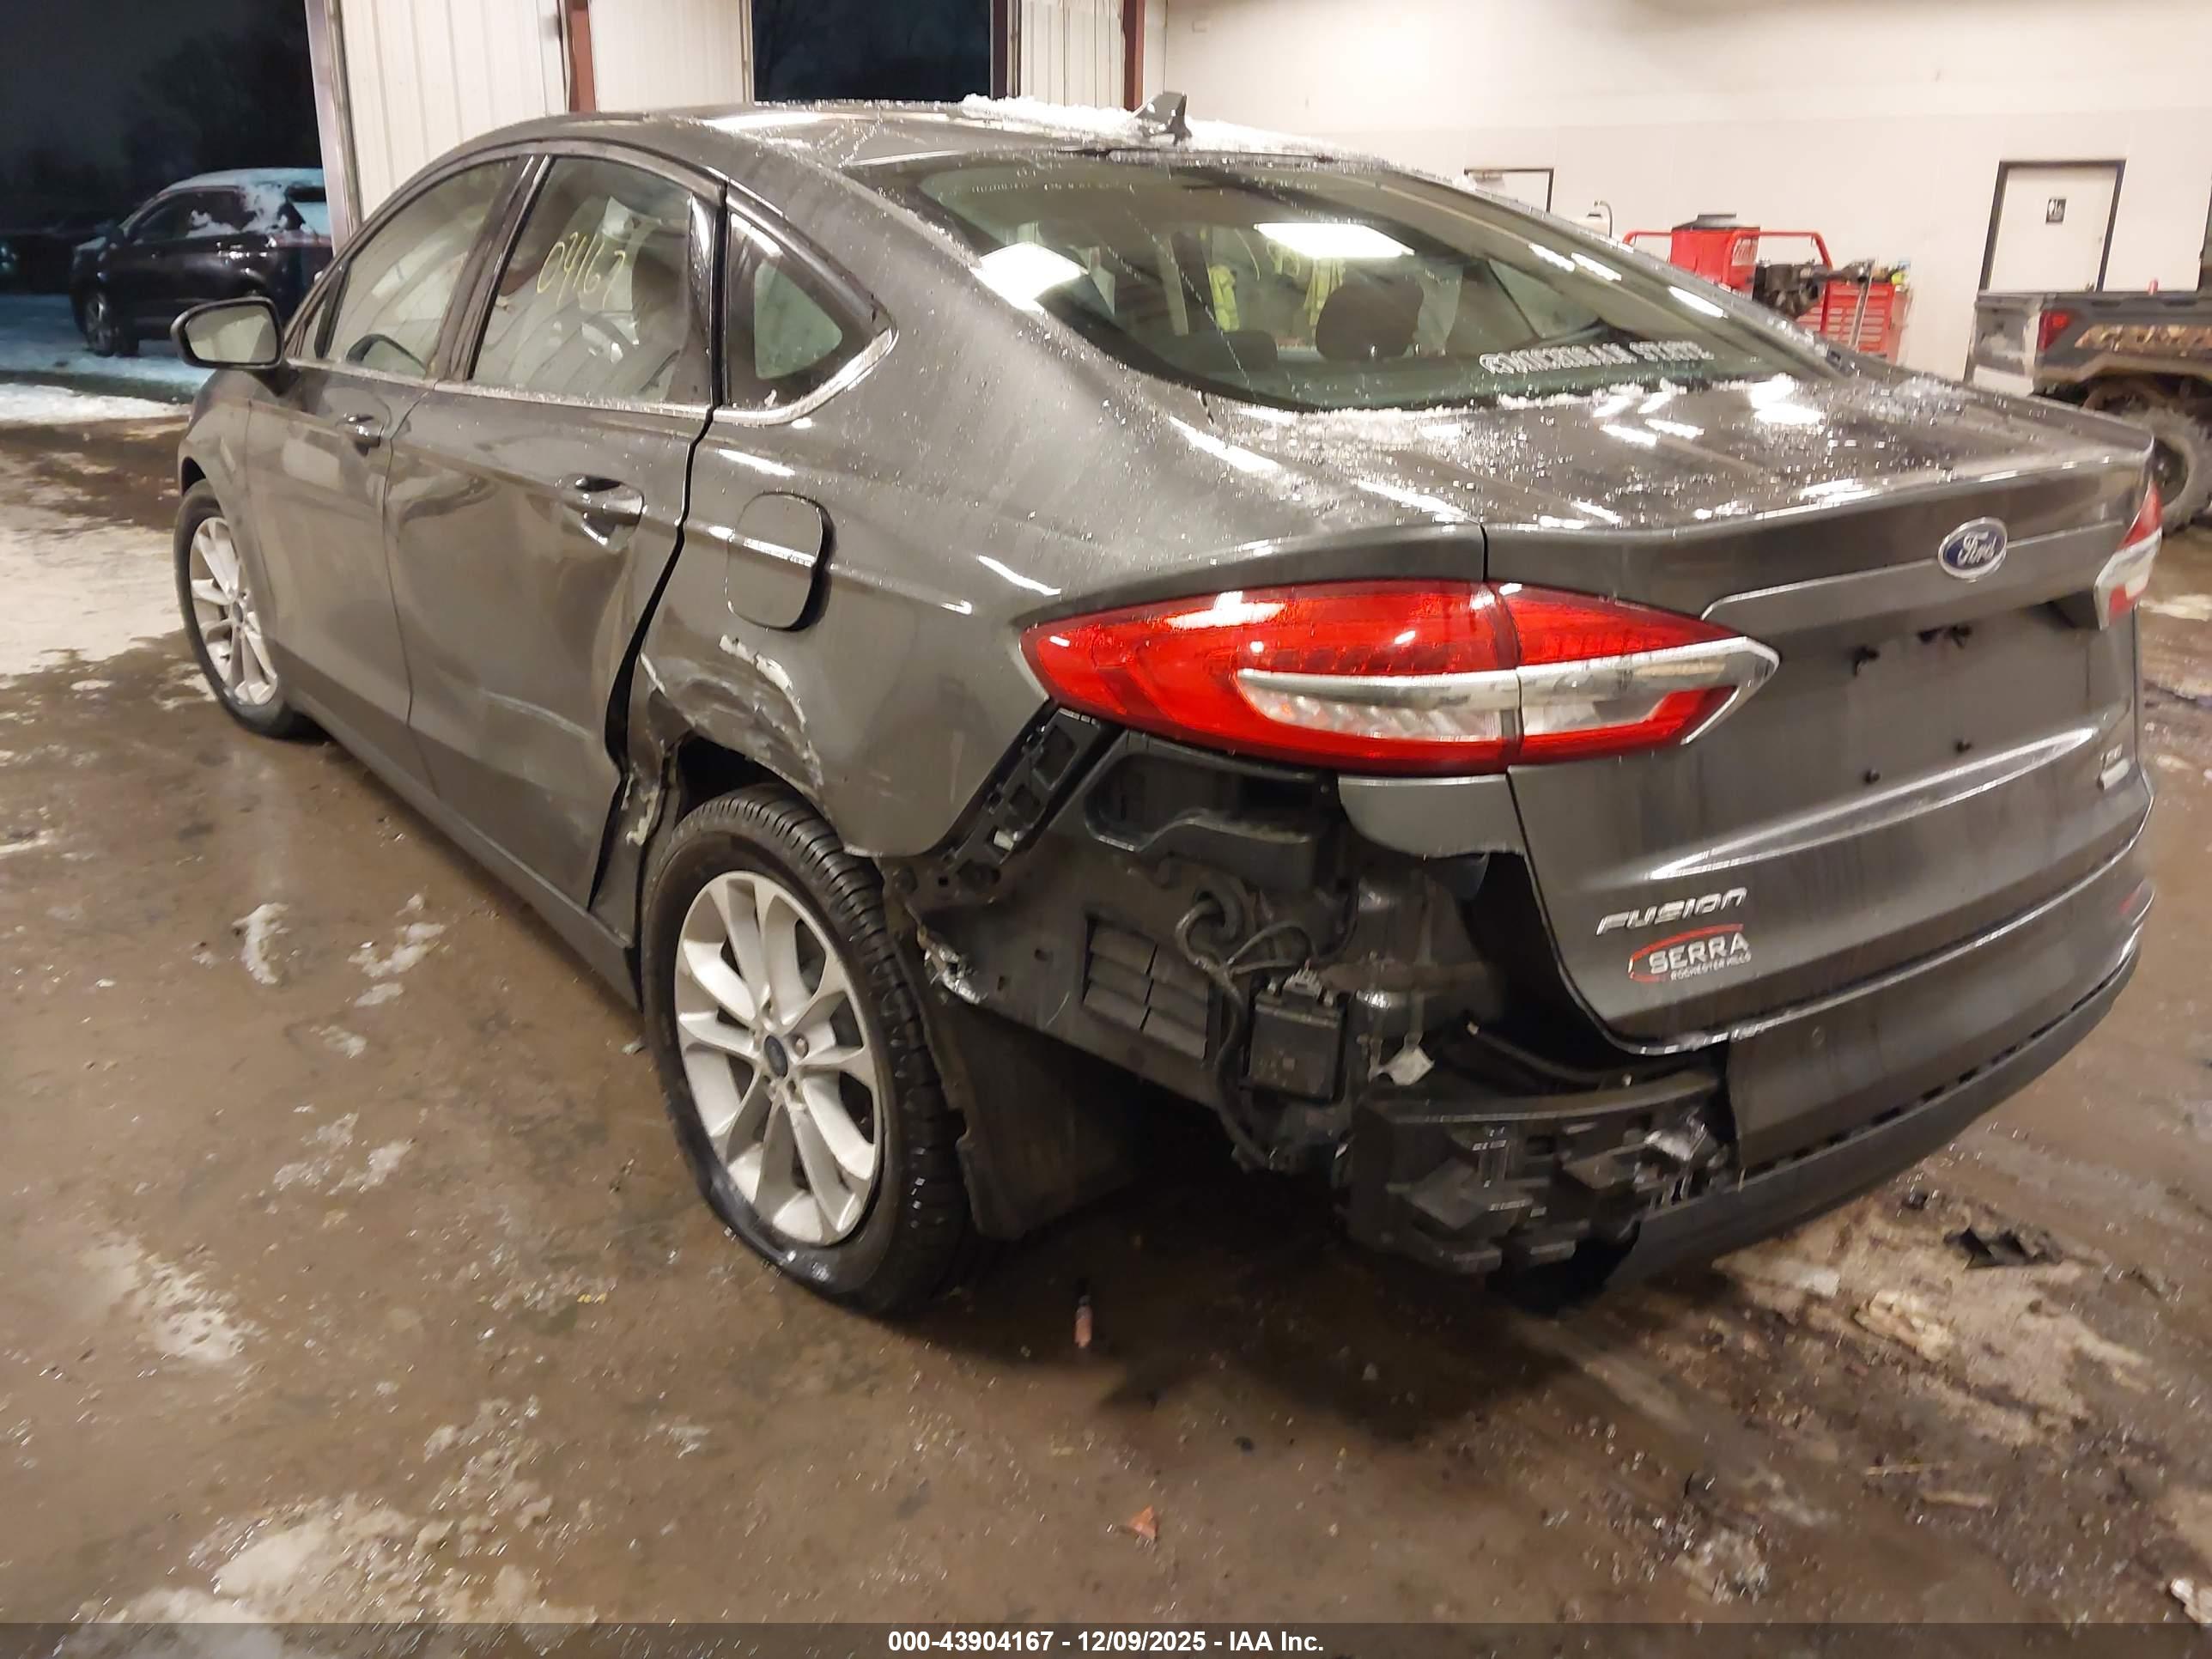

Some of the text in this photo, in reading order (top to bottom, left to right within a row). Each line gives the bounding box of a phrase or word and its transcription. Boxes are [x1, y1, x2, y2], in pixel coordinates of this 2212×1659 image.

[1957, 531, 1997, 567] Ford
[1596, 887, 1747, 936] FUSION
[1649, 932, 1750, 975] SERRA
